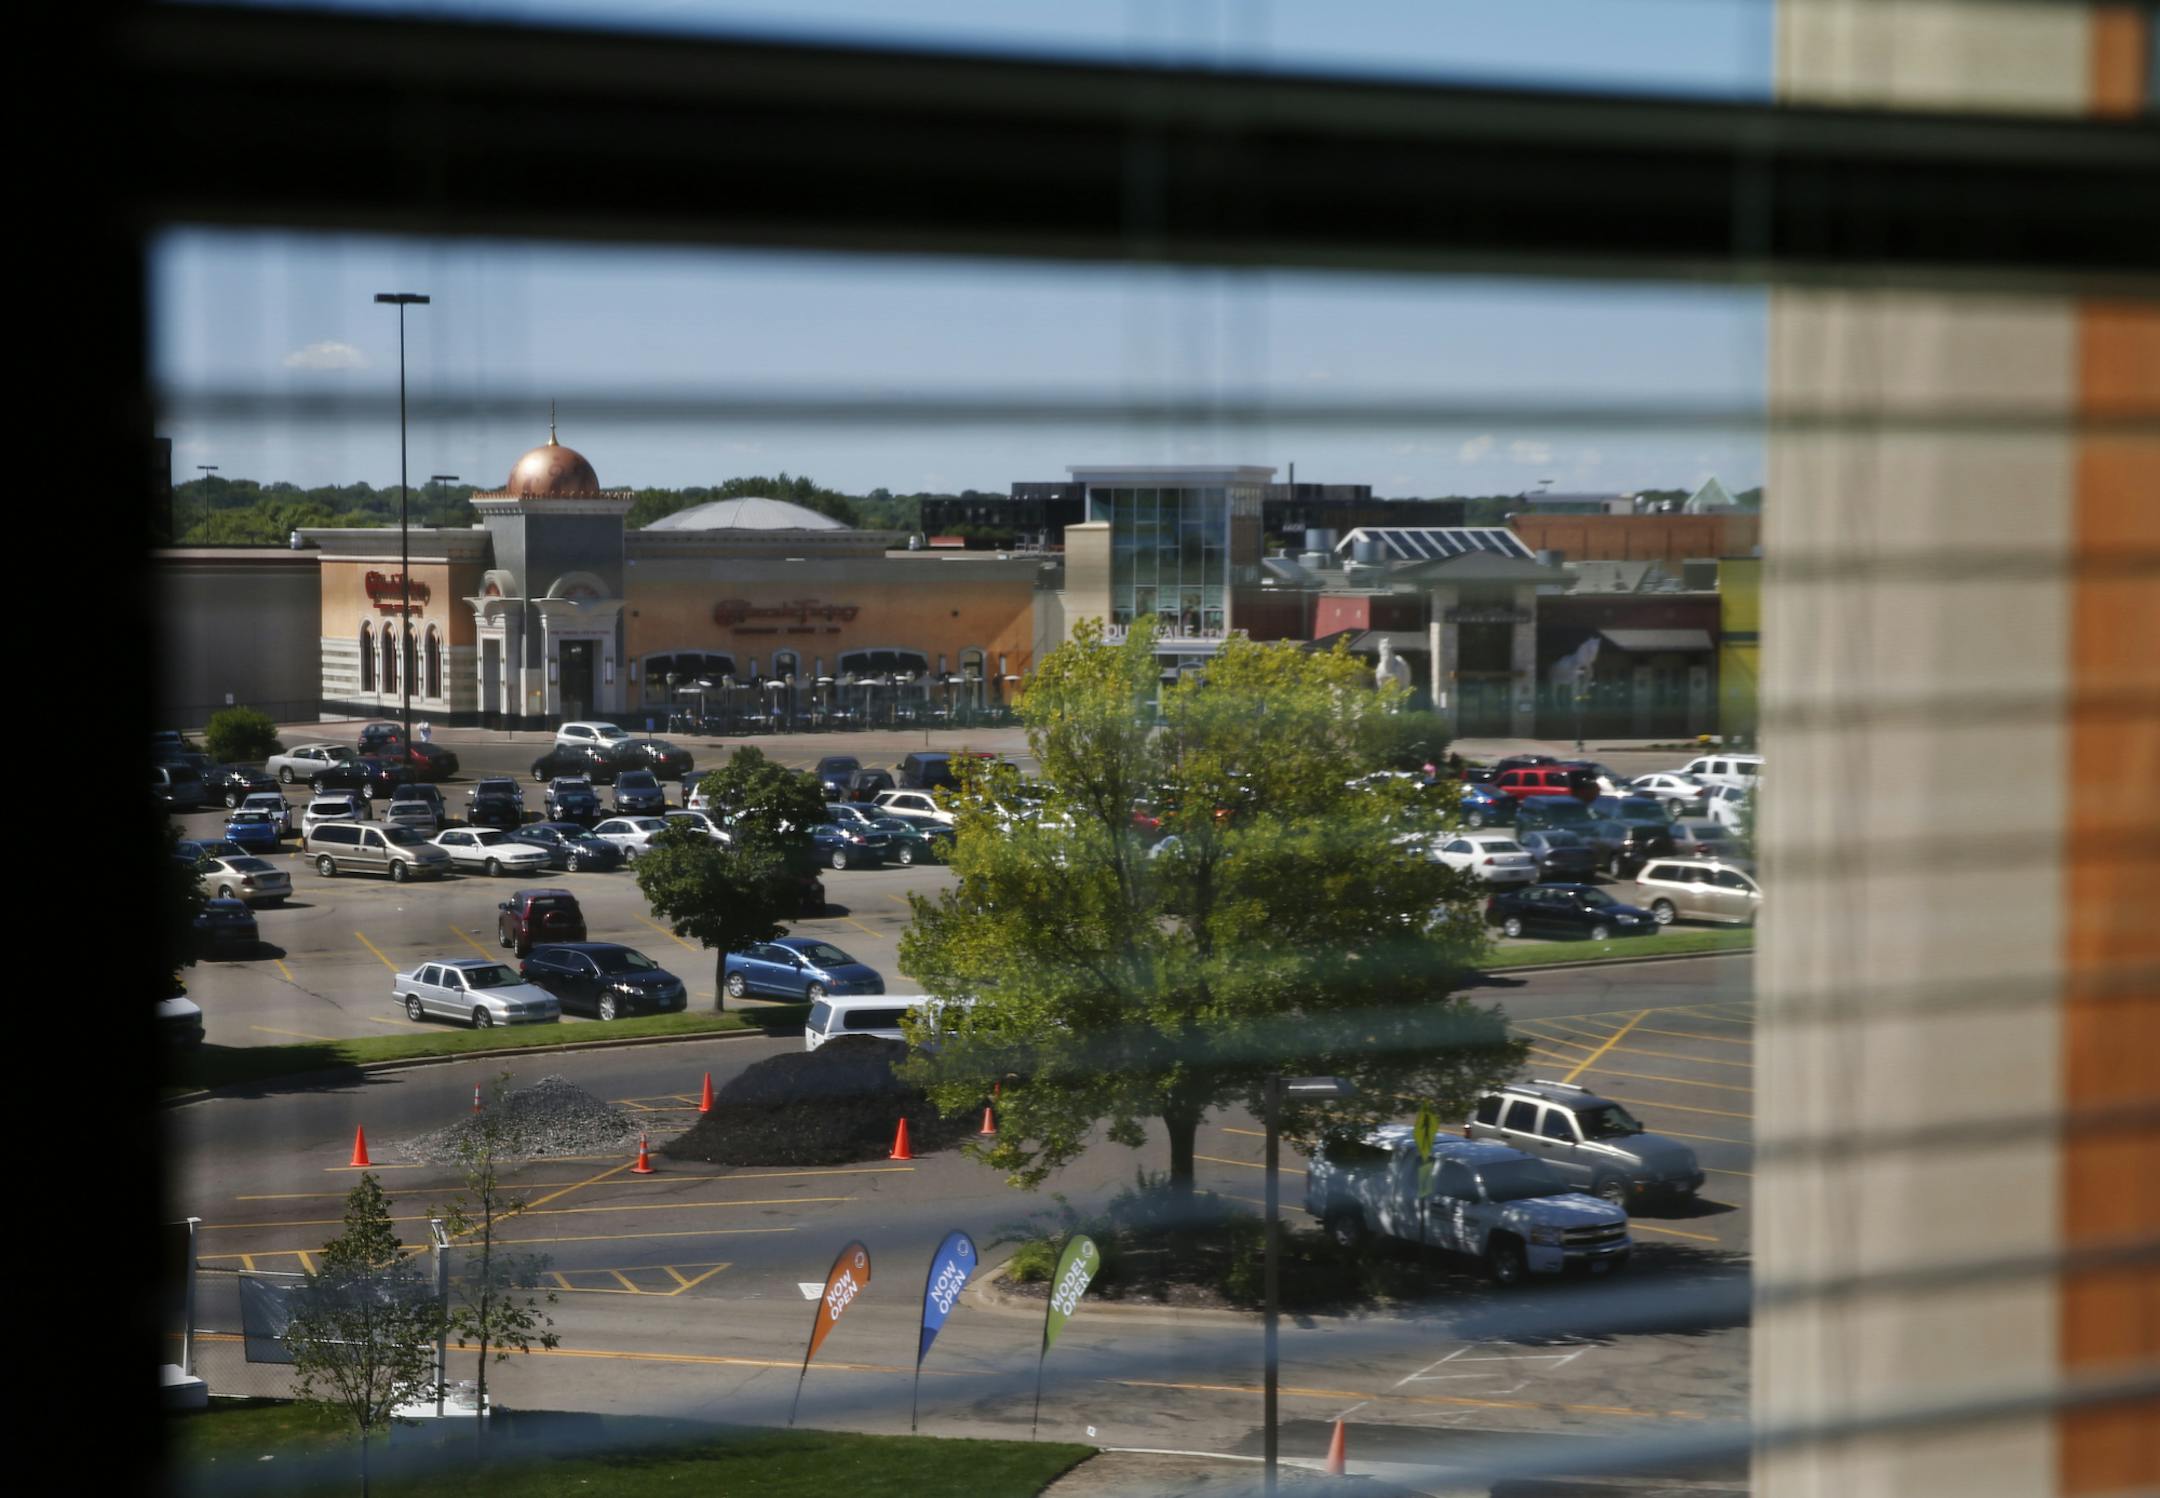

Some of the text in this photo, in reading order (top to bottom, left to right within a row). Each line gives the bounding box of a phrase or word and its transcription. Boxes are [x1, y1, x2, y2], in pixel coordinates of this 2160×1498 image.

[826, 1269, 851, 1307] NOW
[831, 1280, 858, 1320] OPEN
[931, 1260, 957, 1302] NOW
[939, 1269, 966, 1314] OPEN
[1051, 1257, 1086, 1312] MODEL
[1063, 1271, 1091, 1316] OPEN
